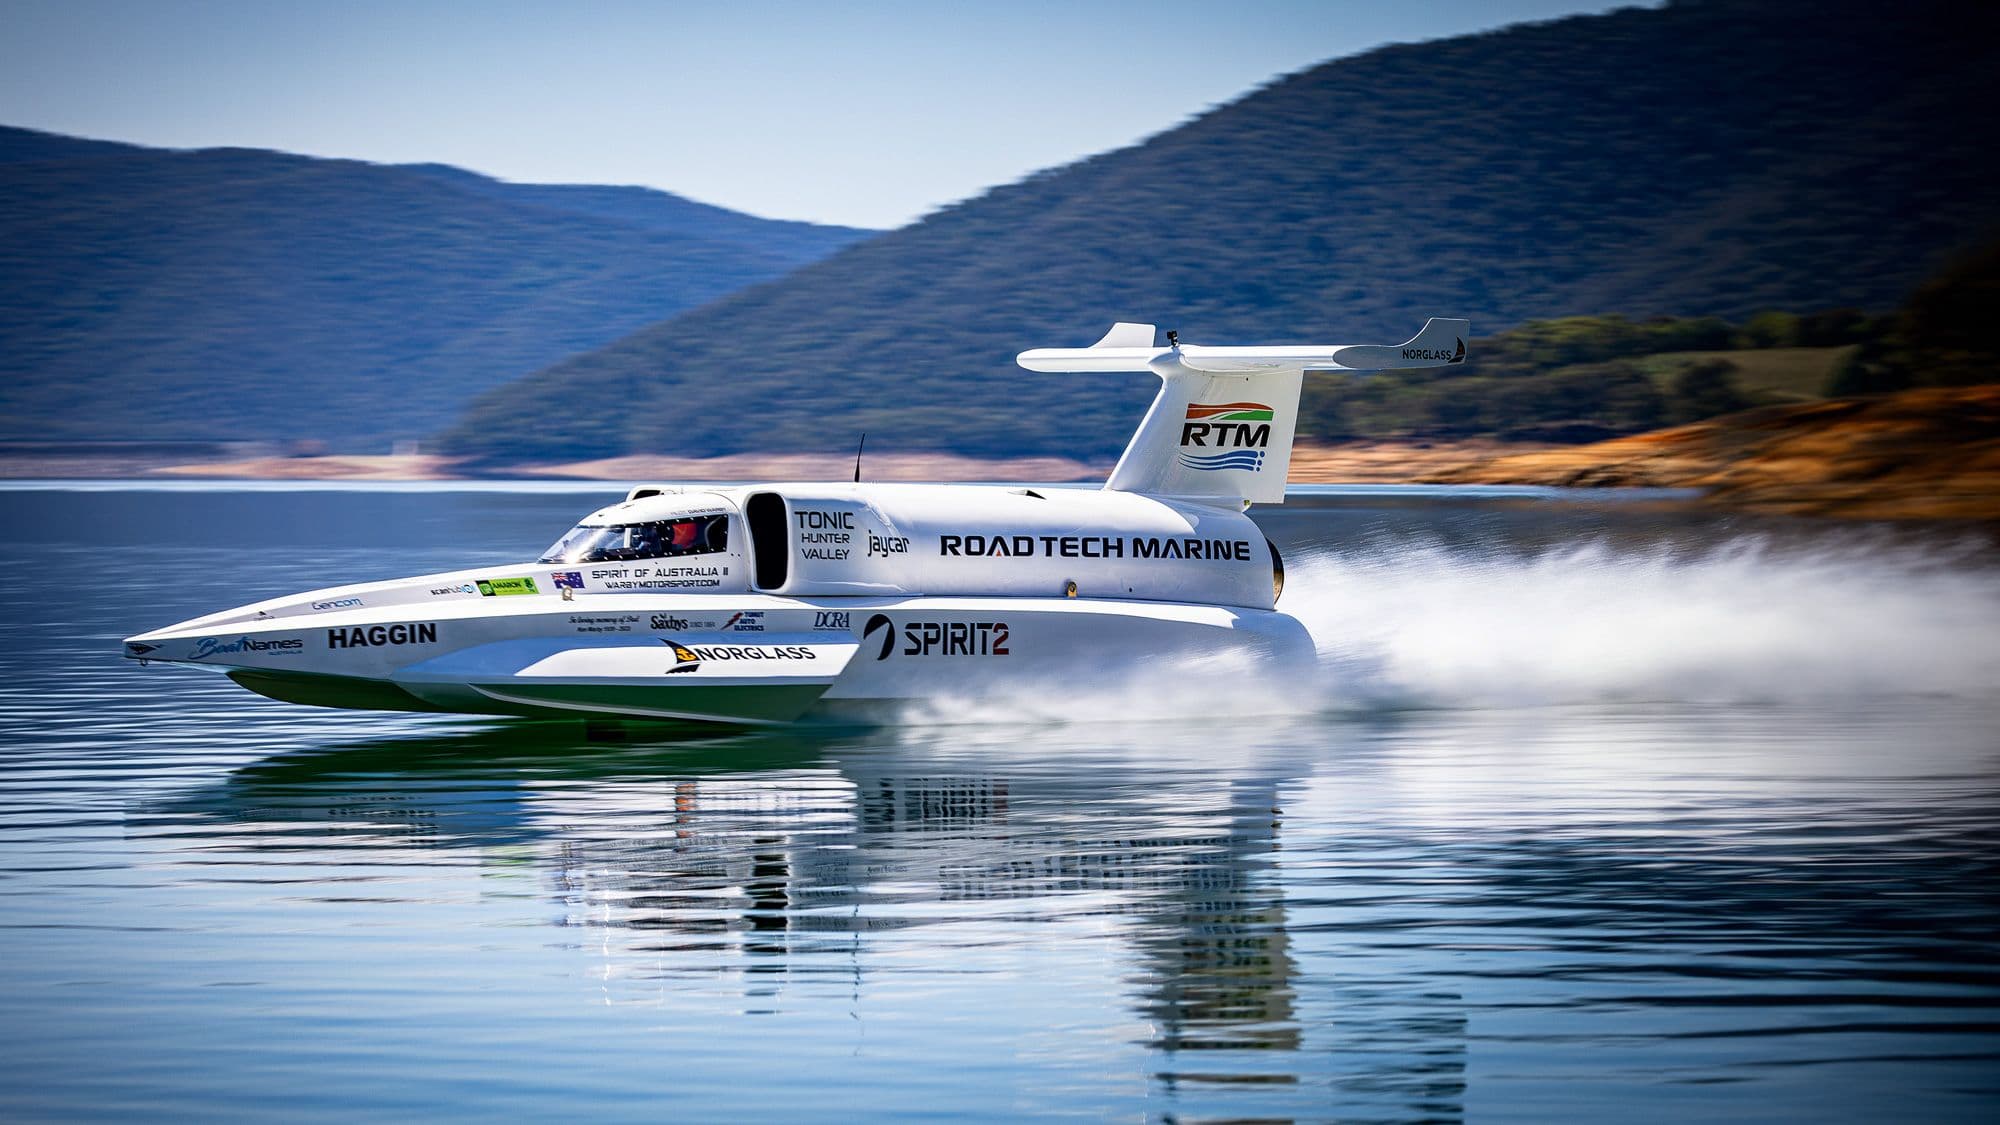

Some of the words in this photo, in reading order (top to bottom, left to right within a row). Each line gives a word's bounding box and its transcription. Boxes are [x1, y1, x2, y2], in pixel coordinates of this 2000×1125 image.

[1402, 349, 1452, 361] NORGLASS
[1180, 423, 1271, 448] RTM
[794, 511, 855, 530] TONIC
[801, 533, 850, 544] HUNTER
[867, 530, 910, 558] jaycar
[801, 548, 850, 560] VALLEY
[940, 535, 1034, 557] ROAD
[1039, 536, 1124, 558] TECH
[1132, 537, 1250, 561] MARINE
[591, 569, 630, 579] SPIRIT
[634, 568, 650, 578] OF
[655, 567, 719, 577] AUSTRALIA
[650, 615, 689, 631] Saxbys
[814, 611, 850, 628] DCRA
[328, 622, 437, 649] HAGGIN
[697, 647, 817, 661] NORGLASS
